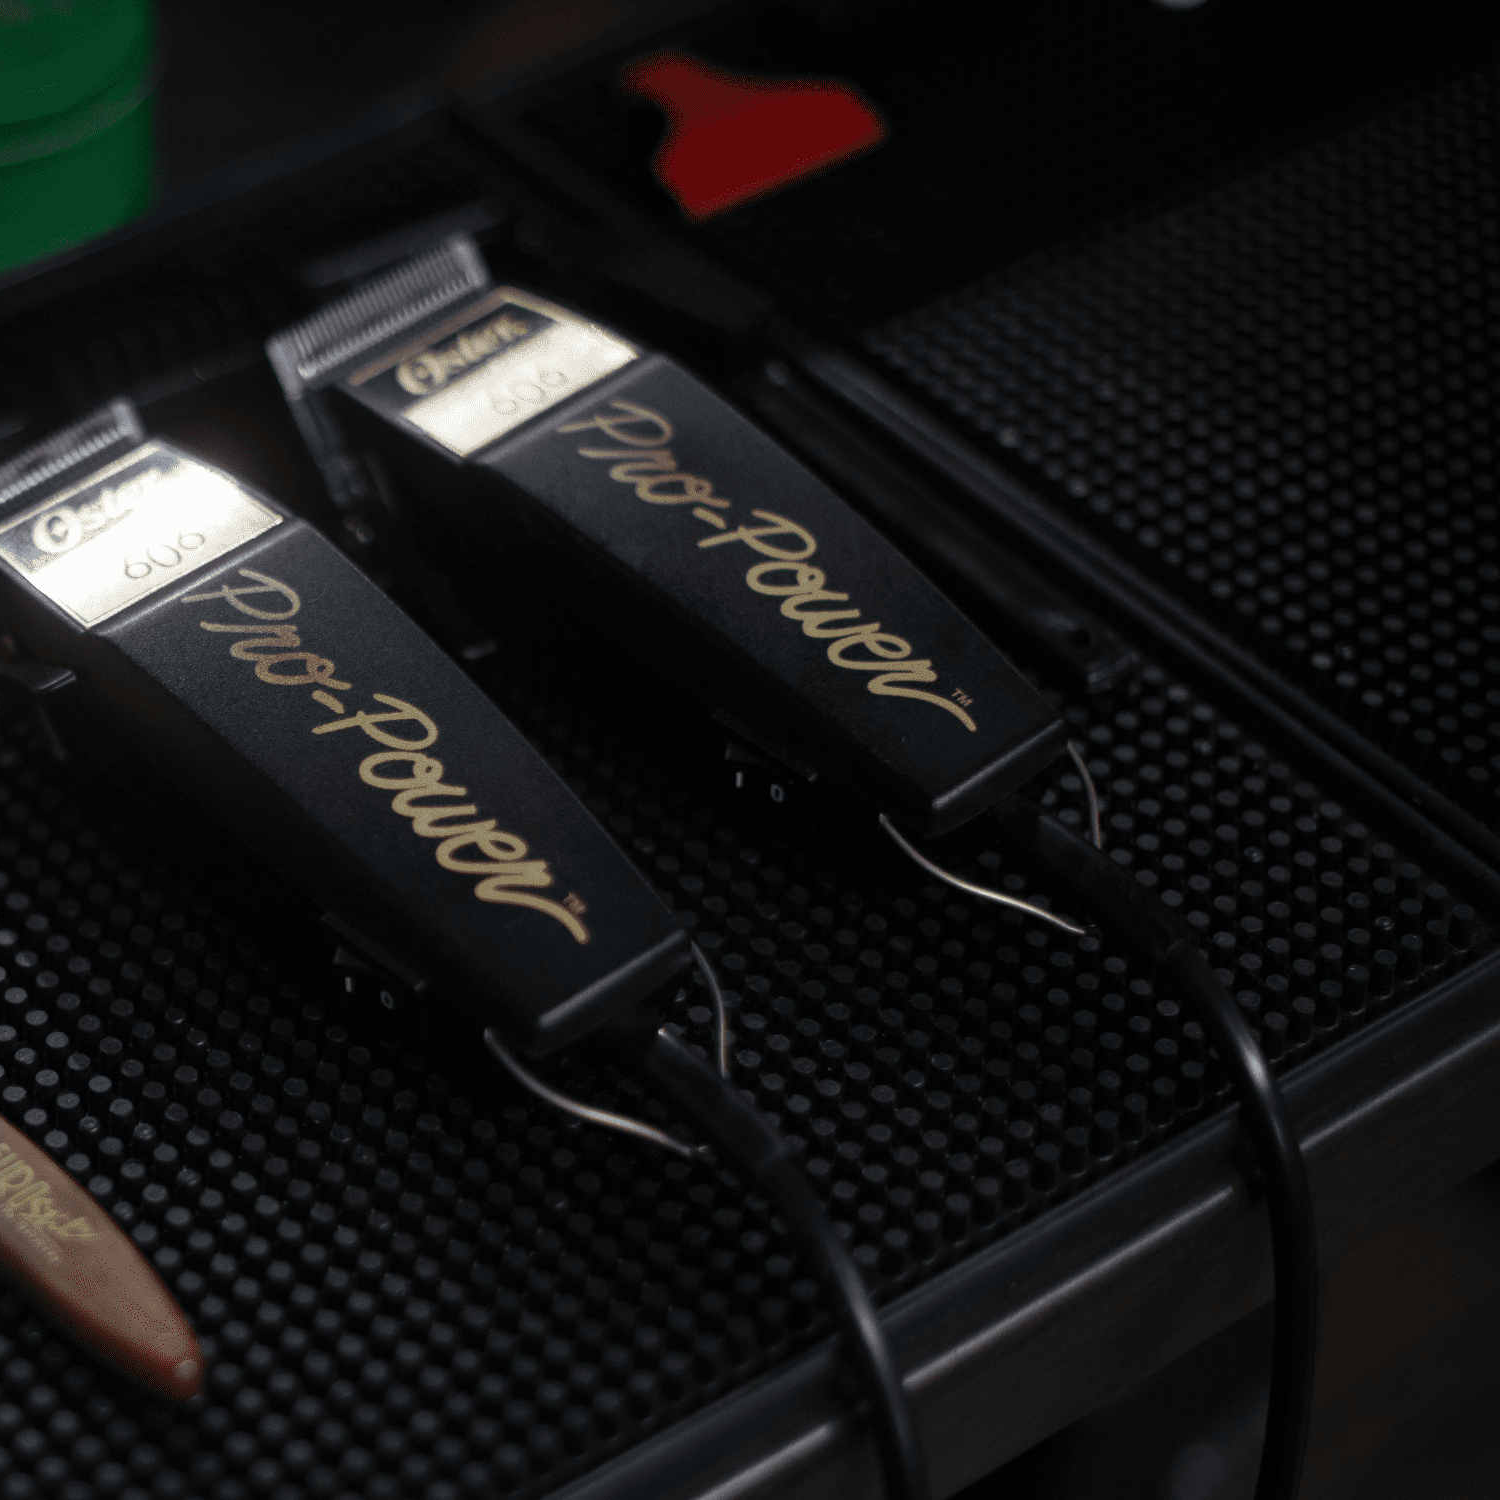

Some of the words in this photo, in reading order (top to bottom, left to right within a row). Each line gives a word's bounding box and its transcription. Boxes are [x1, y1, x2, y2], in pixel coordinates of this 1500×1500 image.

[395, 313, 529, 396] Oster
[489, 365, 568, 416] 606
[123, 530, 207, 579] 606
[557, 400, 977, 732] Pro-Power
[180, 568, 590, 945] Pro-Power
